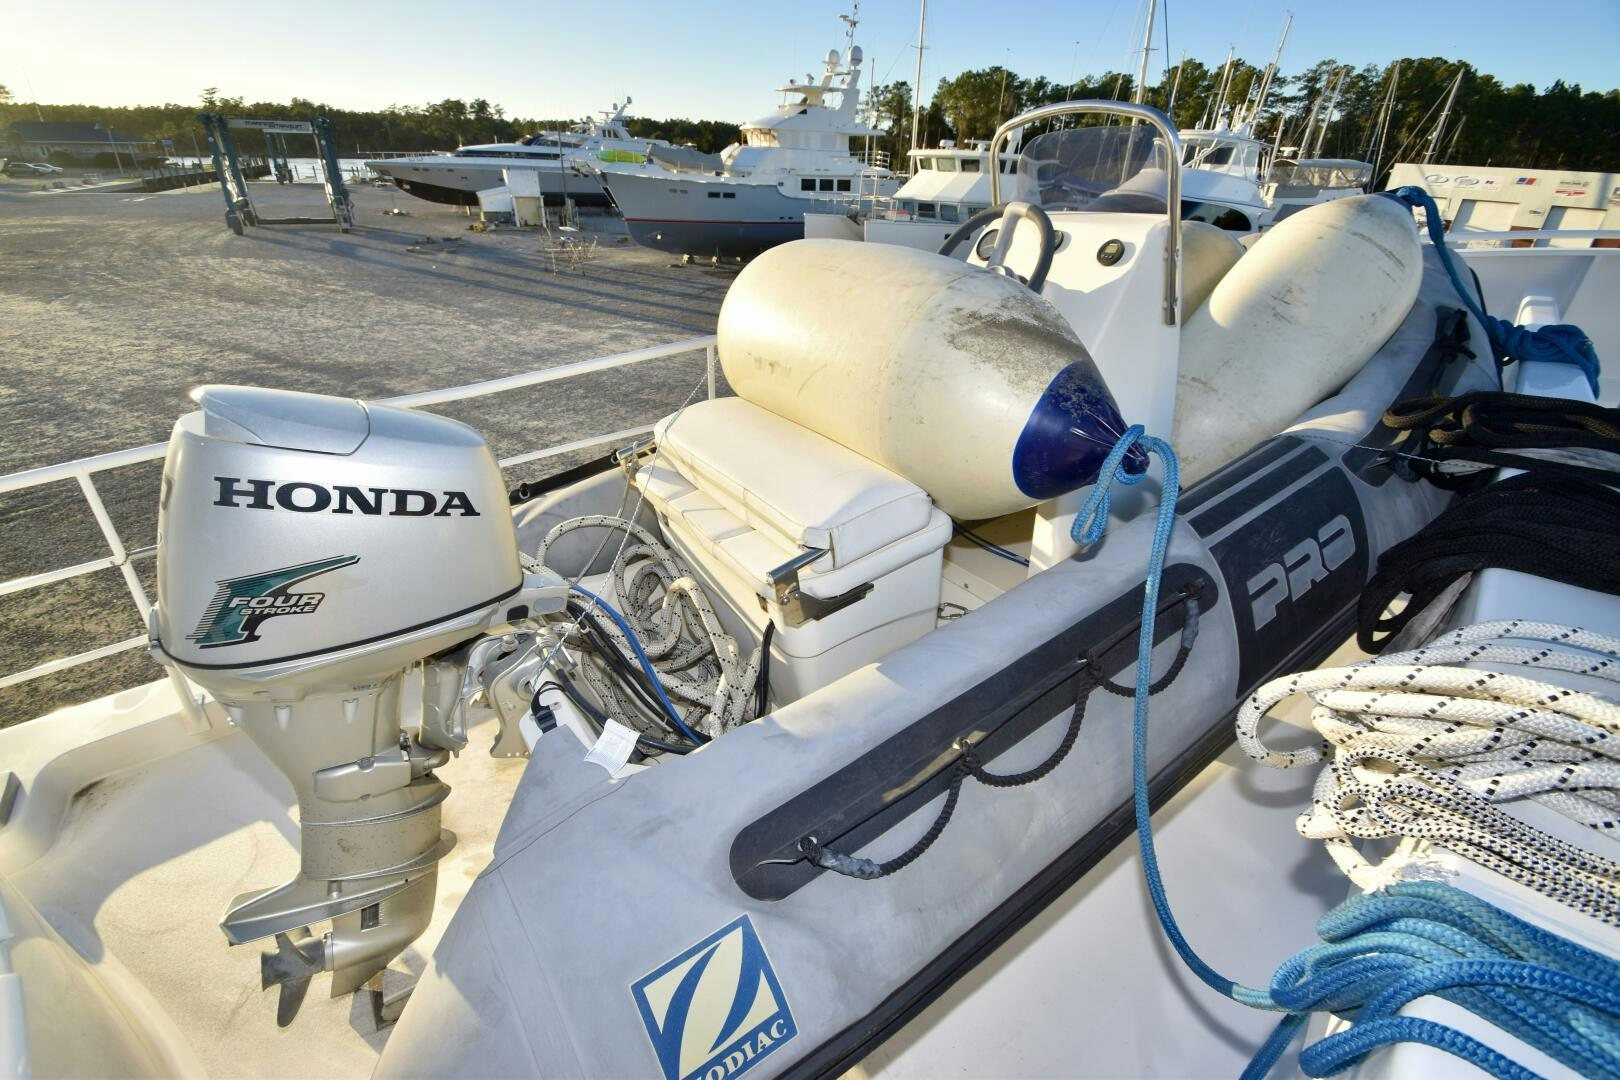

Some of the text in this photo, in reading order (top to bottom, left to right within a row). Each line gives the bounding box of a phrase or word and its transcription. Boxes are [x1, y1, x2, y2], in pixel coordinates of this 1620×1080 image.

[213, 476, 481, 517] HONDA
[1246, 514, 1356, 632] PRO
[228, 593, 323, 608] FOUR
[240, 605, 316, 616] STROKE
[696, 1019, 787, 1080] ODIAC
